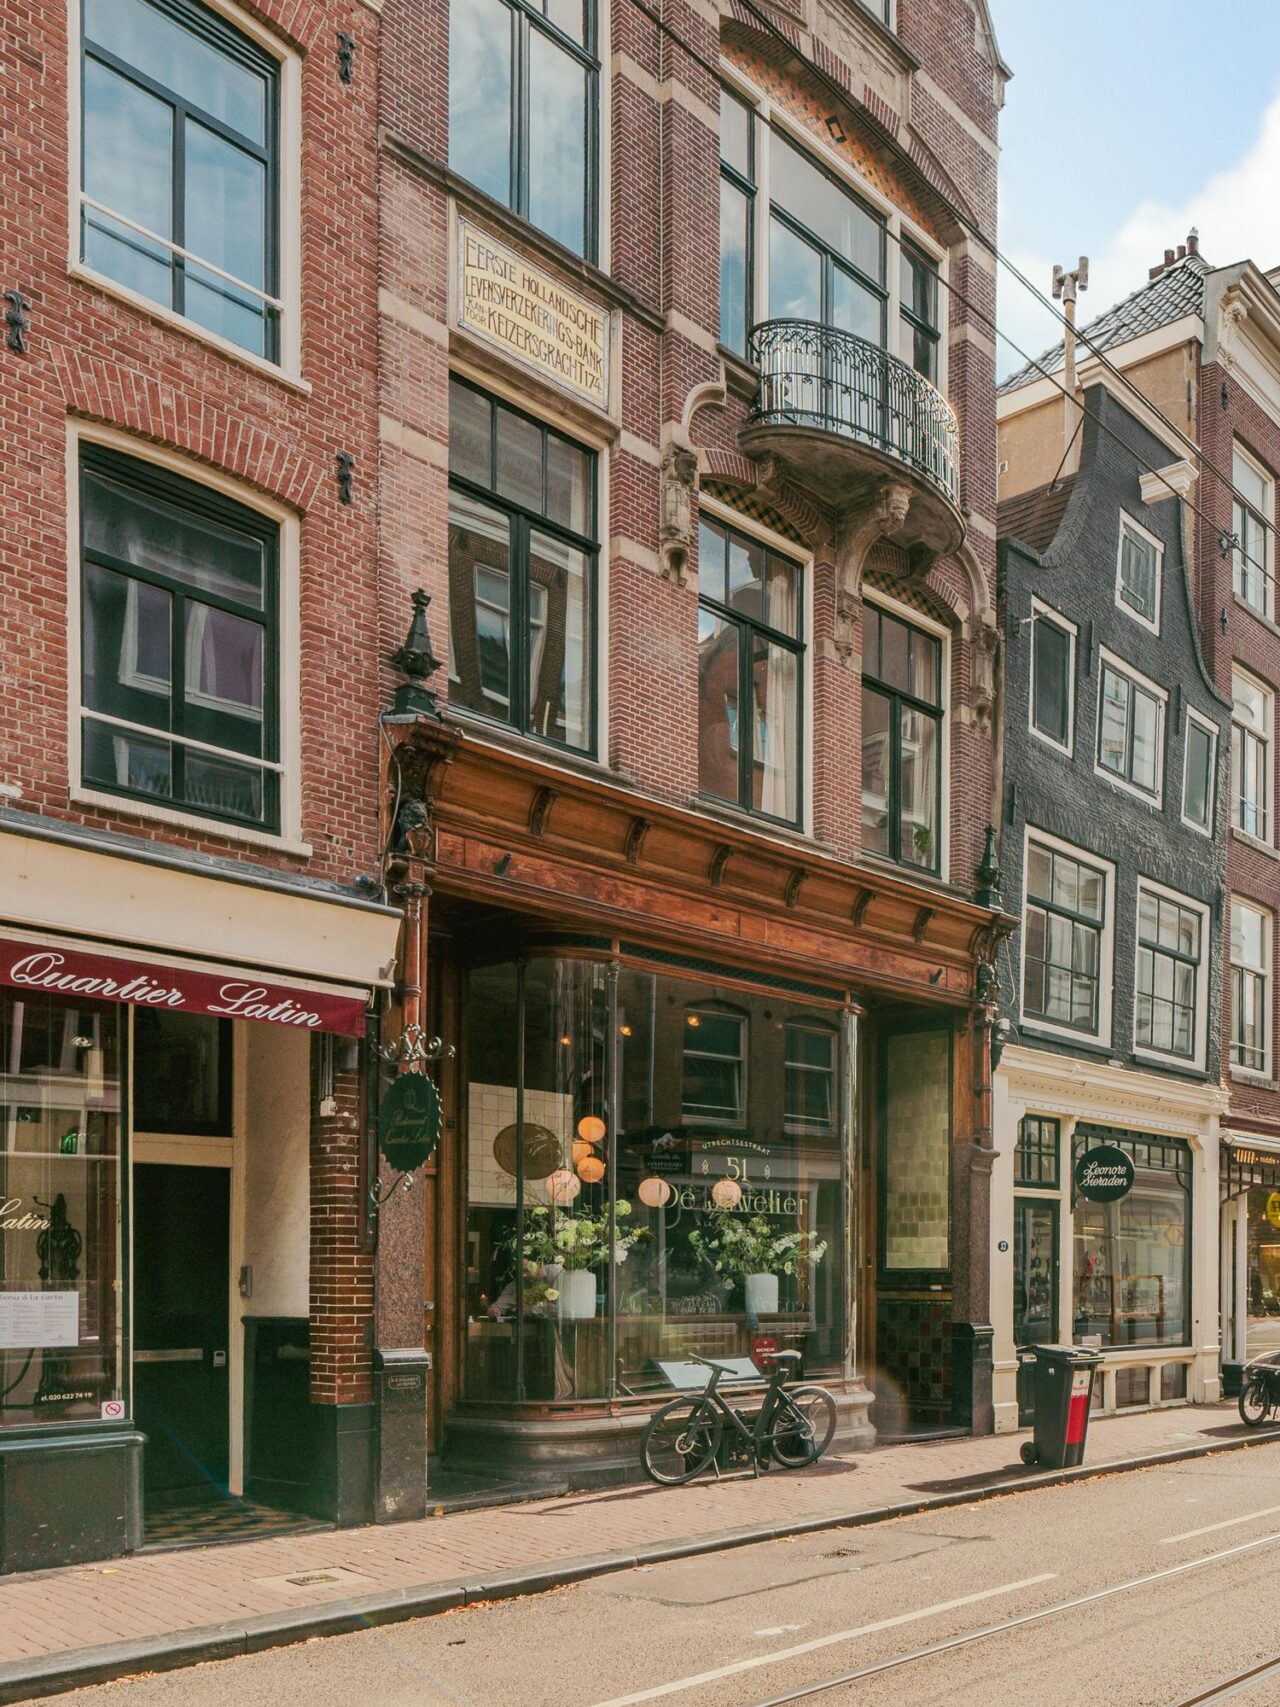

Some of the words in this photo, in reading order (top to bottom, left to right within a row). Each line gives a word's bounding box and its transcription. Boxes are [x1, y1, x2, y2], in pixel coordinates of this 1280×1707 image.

[465, 236, 518, 284] EERSTE
[522, 271, 605, 347] HOLLANDSCHE
[466, 307, 487, 326] TOOR
[487, 309, 585, 385] KEIZERSGRACHT
[9, 952, 186, 1007] Quartier
[206, 982, 323, 1028] Latin
[701, 1138, 772, 1156] UTRECHTSESTRAAT
[726, 1156, 749, 1181] 51
[1080, 1173, 1128, 1188] Sieraden
[1083, 1160, 1128, 1177] Leonore
[658, 1182, 696, 1210] De
[0, 1197, 52, 1231] Latin
[48, 1393, 62, 1401] 020
[62, 1392, 74, 1400] 622
